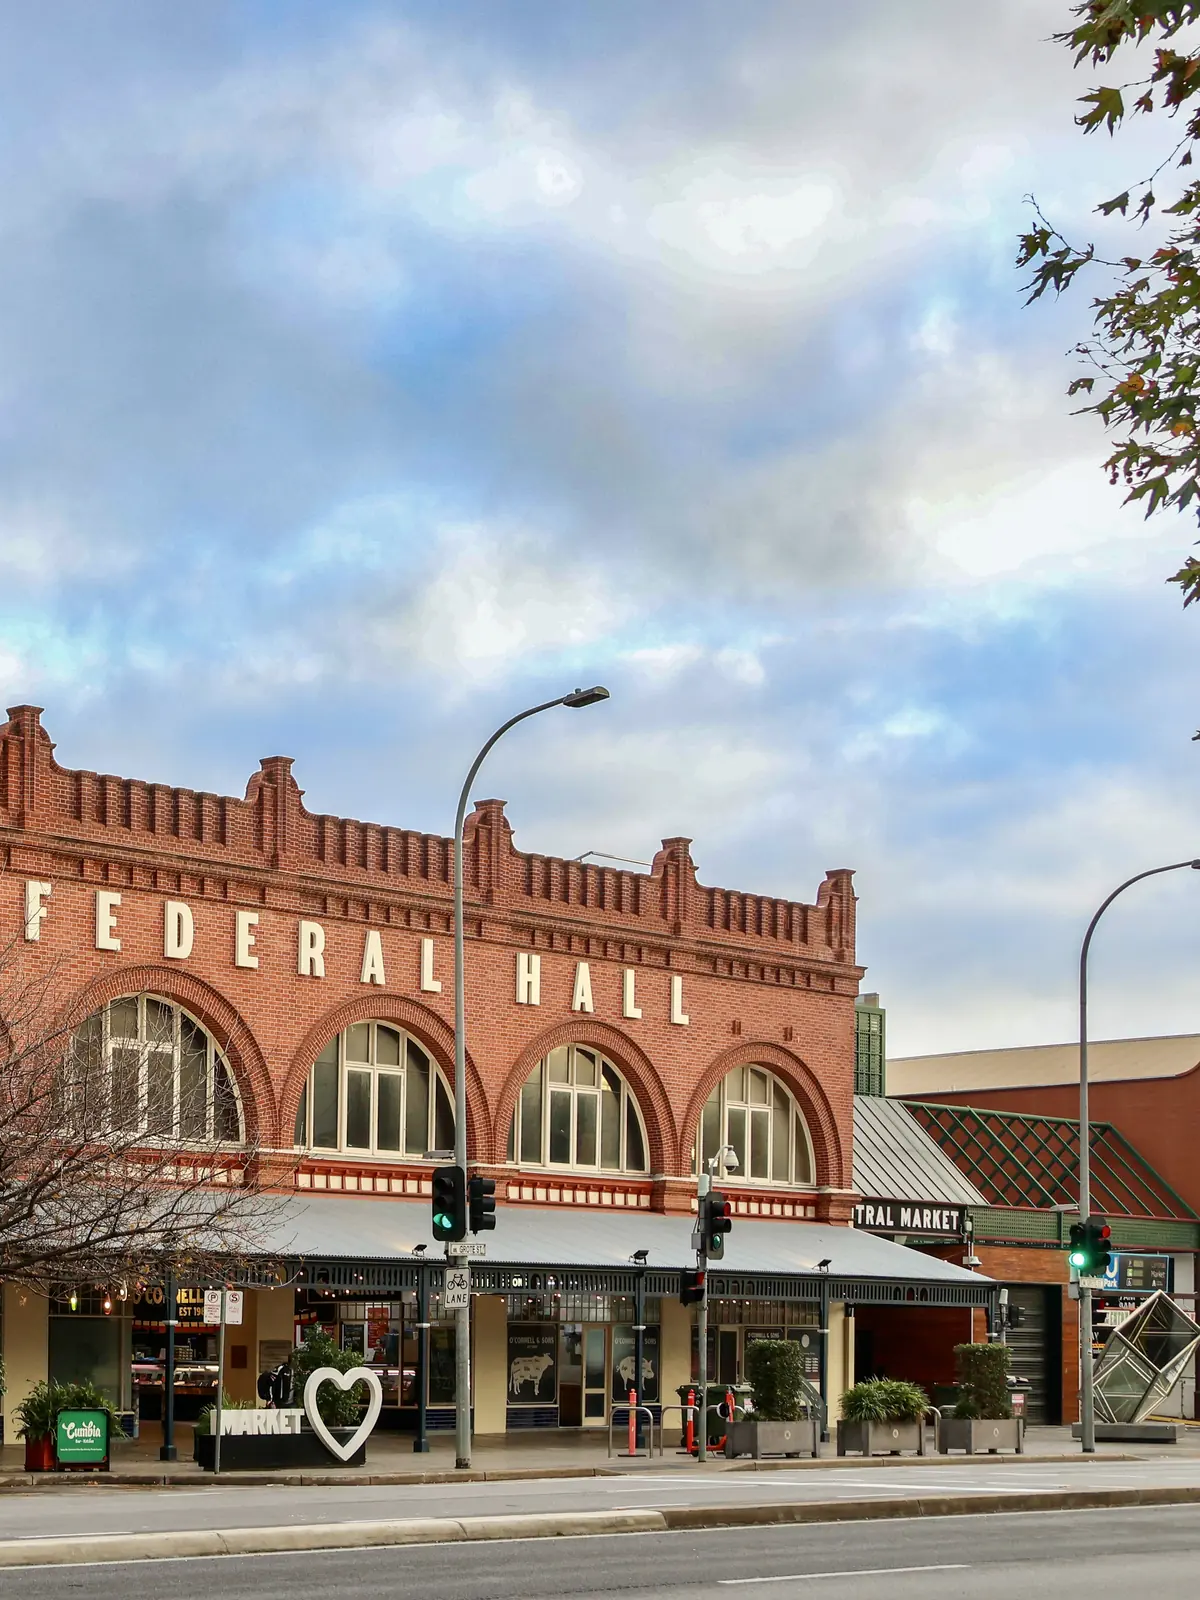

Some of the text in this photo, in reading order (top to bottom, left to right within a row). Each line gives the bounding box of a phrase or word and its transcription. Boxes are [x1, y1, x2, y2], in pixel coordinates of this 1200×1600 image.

[24, 880, 690, 1026] FEDERAL HALL
[851, 1203, 960, 1231] TRAL MARKET
[459, 1244, 476, 1255] GROTE
[1103, 1278, 1118, 1288] Park
[446, 1293, 468, 1305] LANE
[179, 1307, 192, 1317] EST
[61, 1420, 102, 1440] Cumbia
[210, 1408, 305, 1436] MARKET
